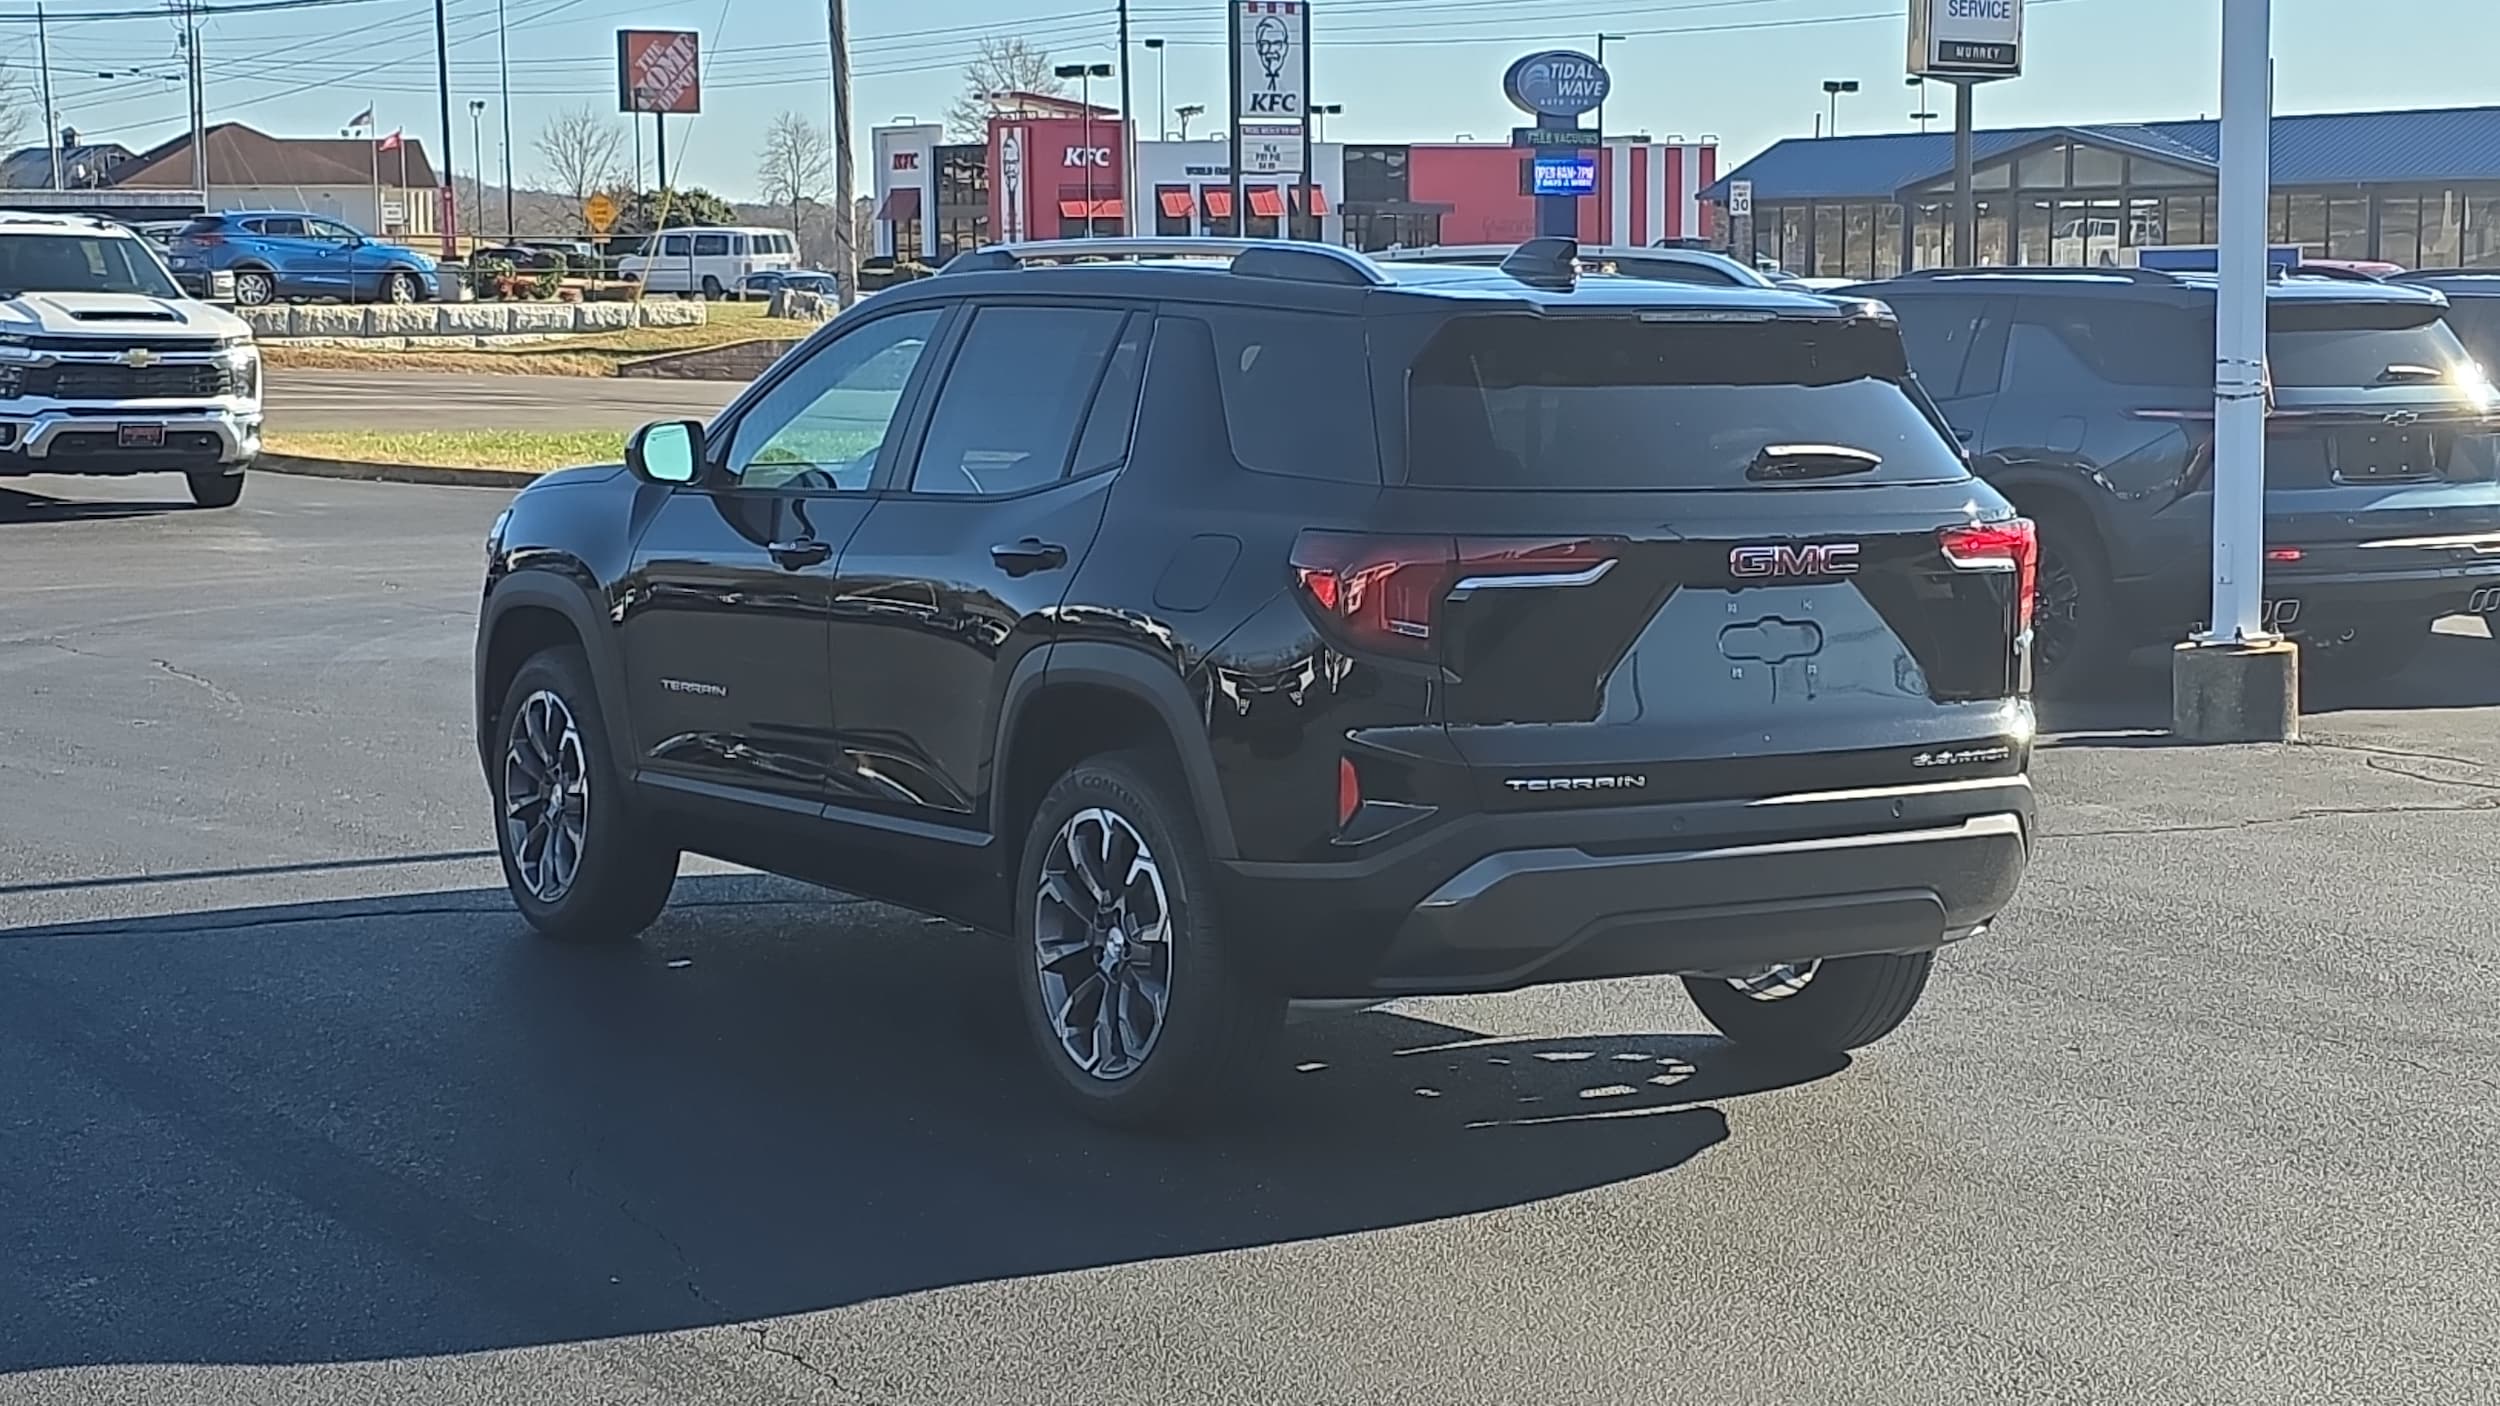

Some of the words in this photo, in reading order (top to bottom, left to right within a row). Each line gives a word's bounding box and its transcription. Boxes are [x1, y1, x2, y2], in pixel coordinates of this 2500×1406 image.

[1949, 0, 2011, 19] SERVICE
[635, 40, 665, 71] THE
[634, 34, 697, 110] HOME
[1551, 63, 1595, 79] TIDAL
[658, 61, 697, 111] DEPOT
[1558, 81, 1604, 96] WAVE
[1249, 93, 1297, 113] KFC
[892, 153, 919, 170] KFC
[1064, 147, 1110, 167] KFC
[1535, 166, 1556, 179] OPEN
[1732, 198, 1749, 211] 30
[1730, 544, 1860, 577] GMC
[660, 679, 726, 697] TERRAIN
[1505, 775, 1646, 791] TERRAIN
